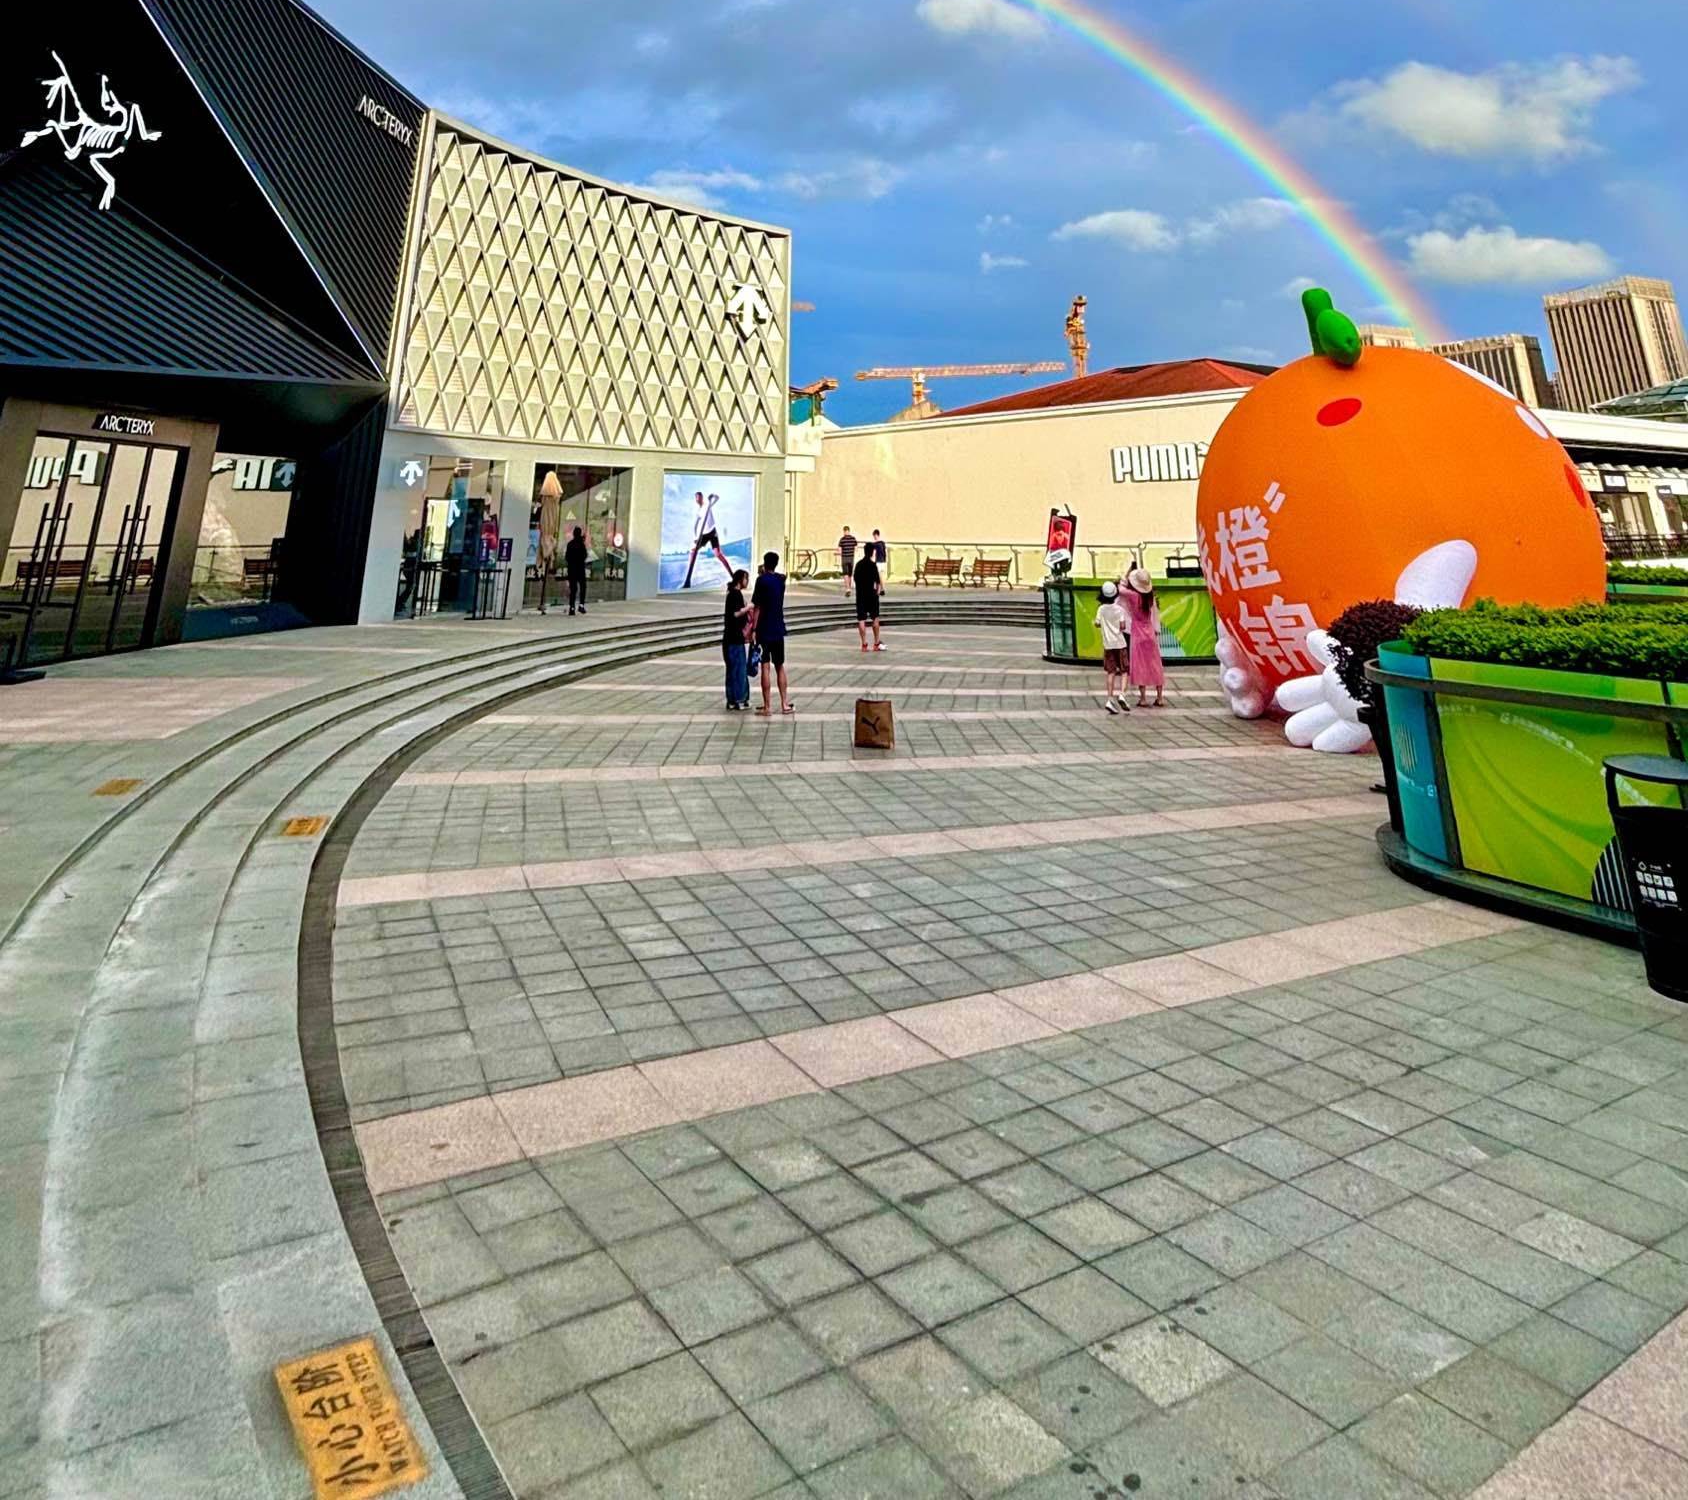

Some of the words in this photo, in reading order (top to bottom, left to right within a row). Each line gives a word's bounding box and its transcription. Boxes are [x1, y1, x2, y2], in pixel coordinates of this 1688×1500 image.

[1110, 443, 1200, 483] PUMA
[345, 1352, 375, 1383] STEP
[360, 1383, 390, 1422] YOUR
[291, 1363, 380, 1485] 小心台阶
[375, 1420, 409, 1475] WATCH
